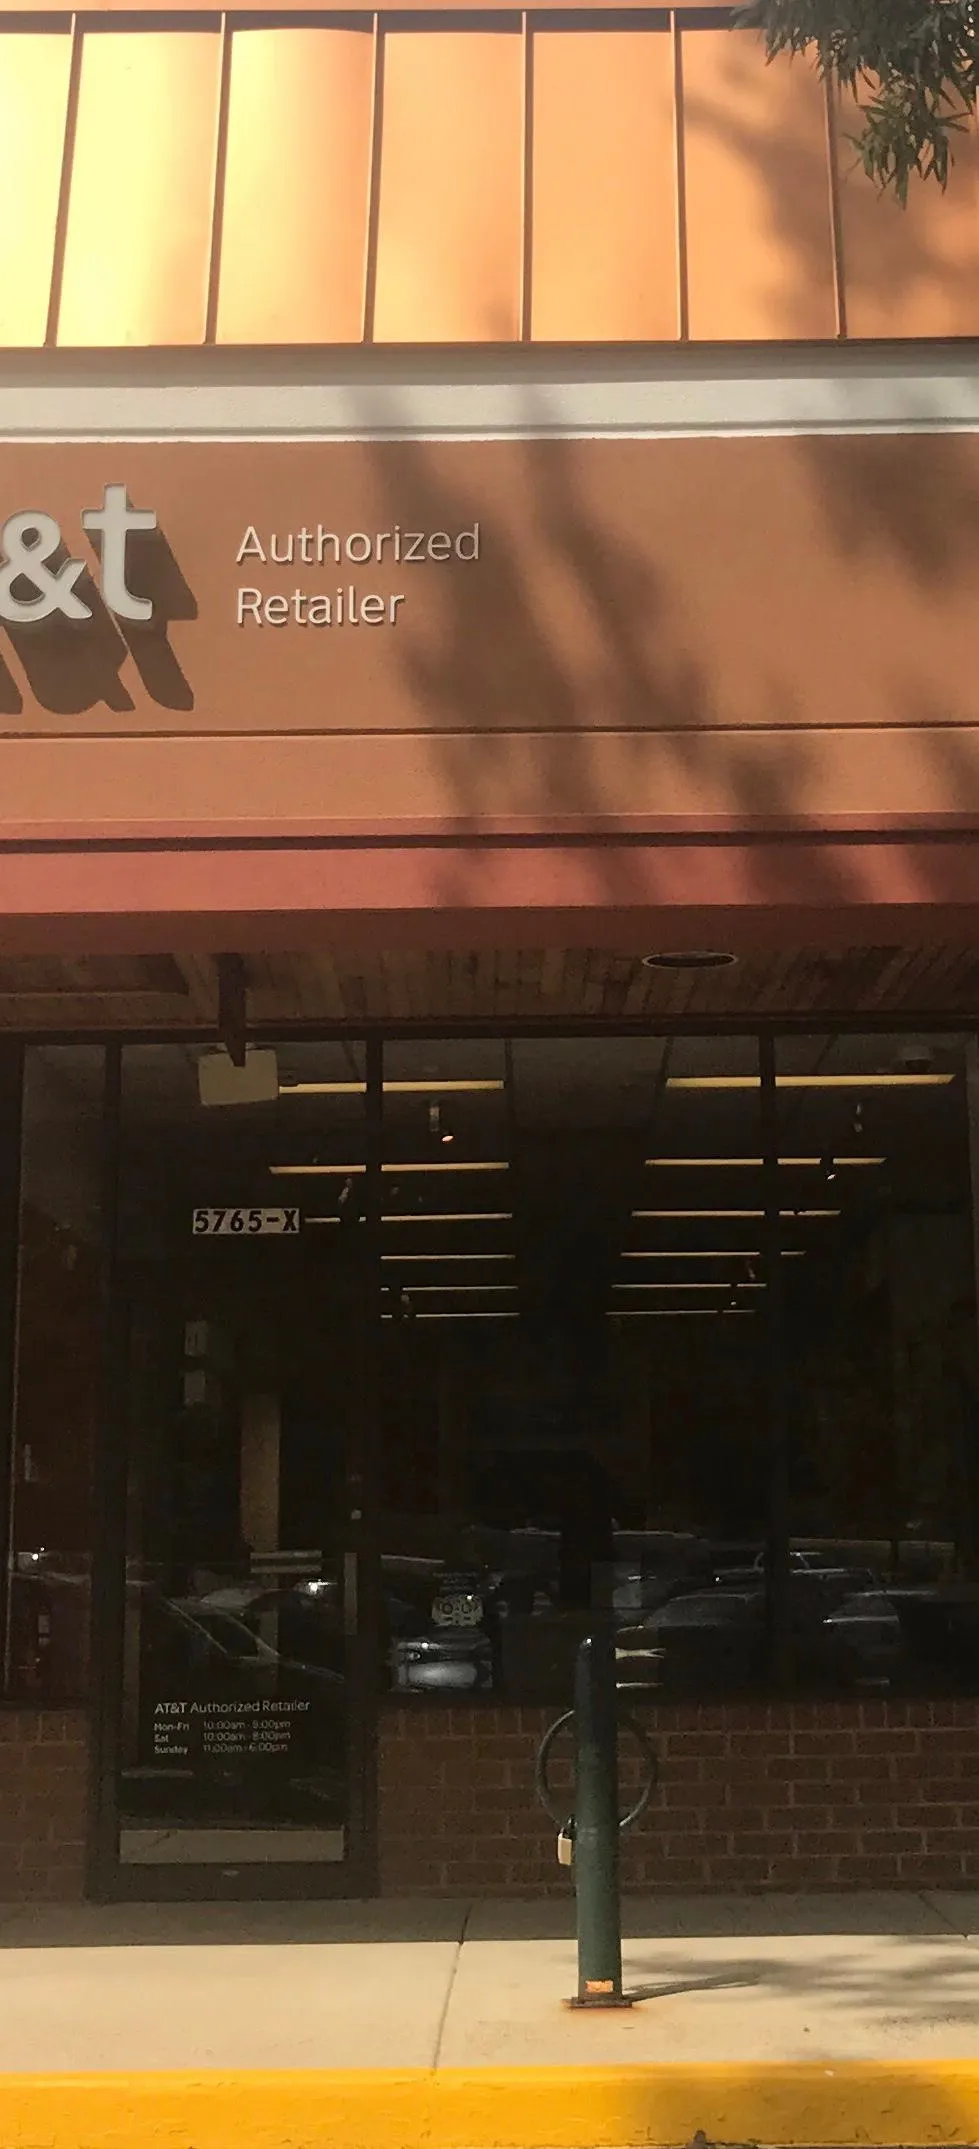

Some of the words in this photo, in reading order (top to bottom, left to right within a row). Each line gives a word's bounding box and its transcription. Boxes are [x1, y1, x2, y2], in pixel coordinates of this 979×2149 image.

[235, 522, 481, 564] Authorized
[236, 586, 405, 626] Retailer
[195, 1210, 297, 1233] 5765-X
[154, 1702, 188, 1715] AT&T
[190, 1700, 260, 1714] Authorized
[262, 1699, 311, 1712] Retailer
[154, 1745, 189, 1755] Sunday
